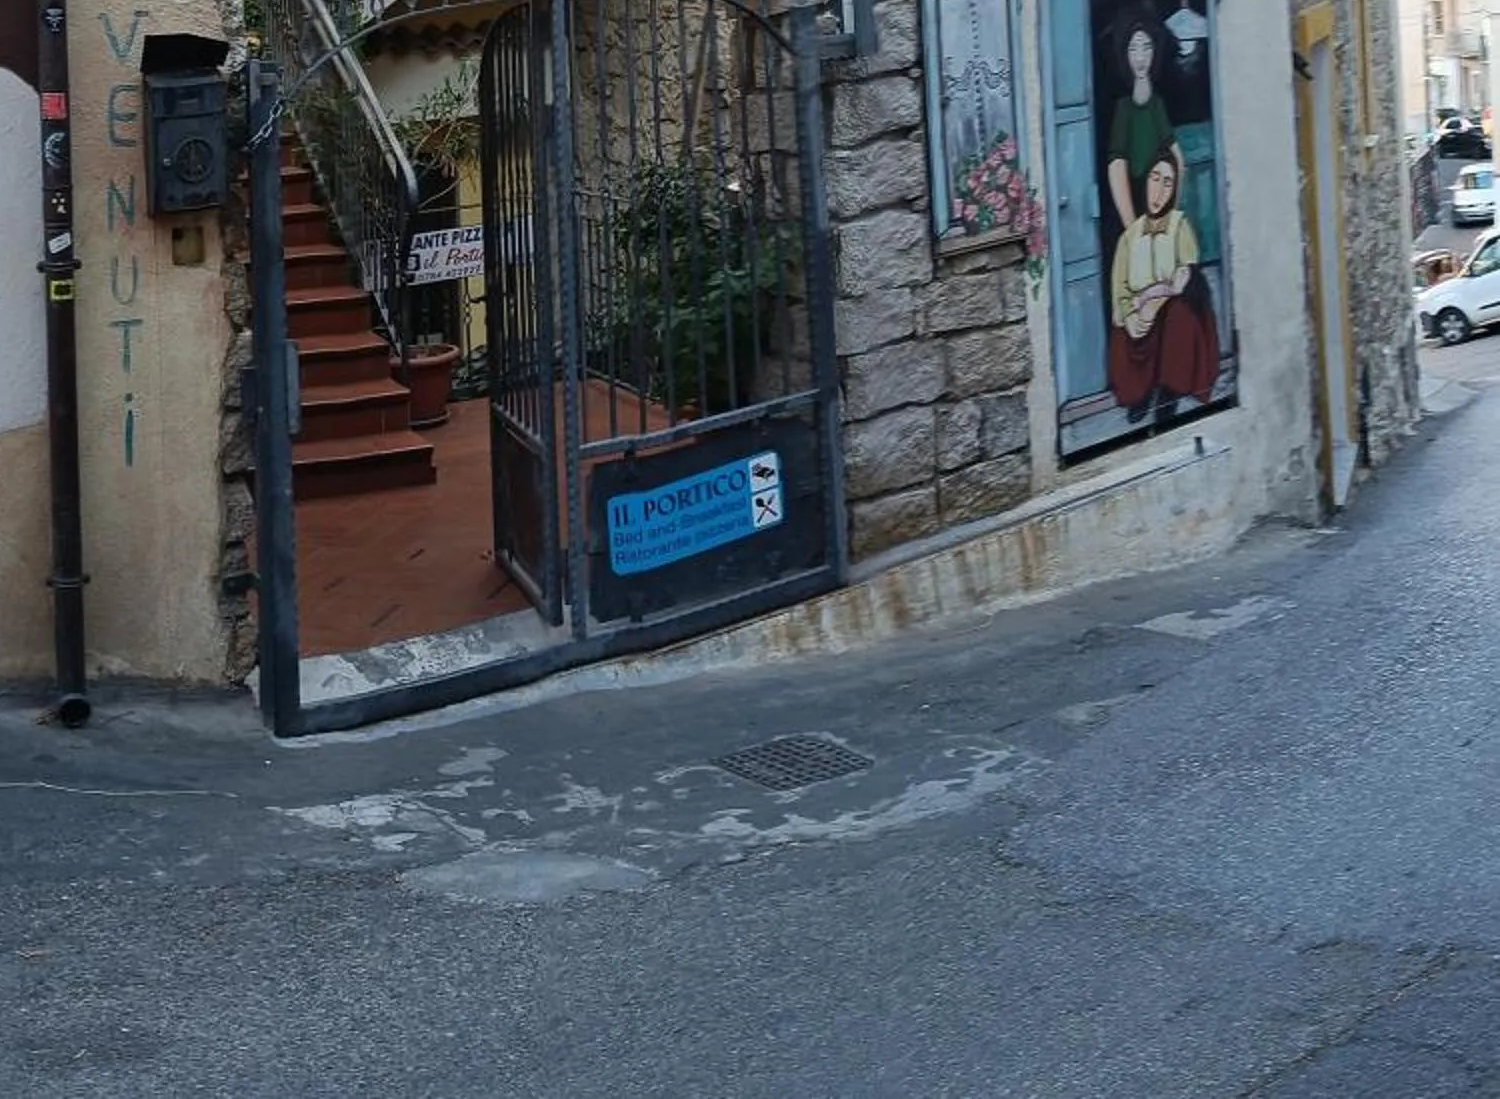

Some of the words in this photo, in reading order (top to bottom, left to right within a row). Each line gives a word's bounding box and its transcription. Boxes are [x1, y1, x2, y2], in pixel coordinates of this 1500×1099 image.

[413, 232, 448, 250] ANTE
[452, 227, 481, 245] PIZZ
[445, 248, 484, 266] Porti
[643, 469, 747, 522] PORTICO
[614, 530, 643, 549] Bed
